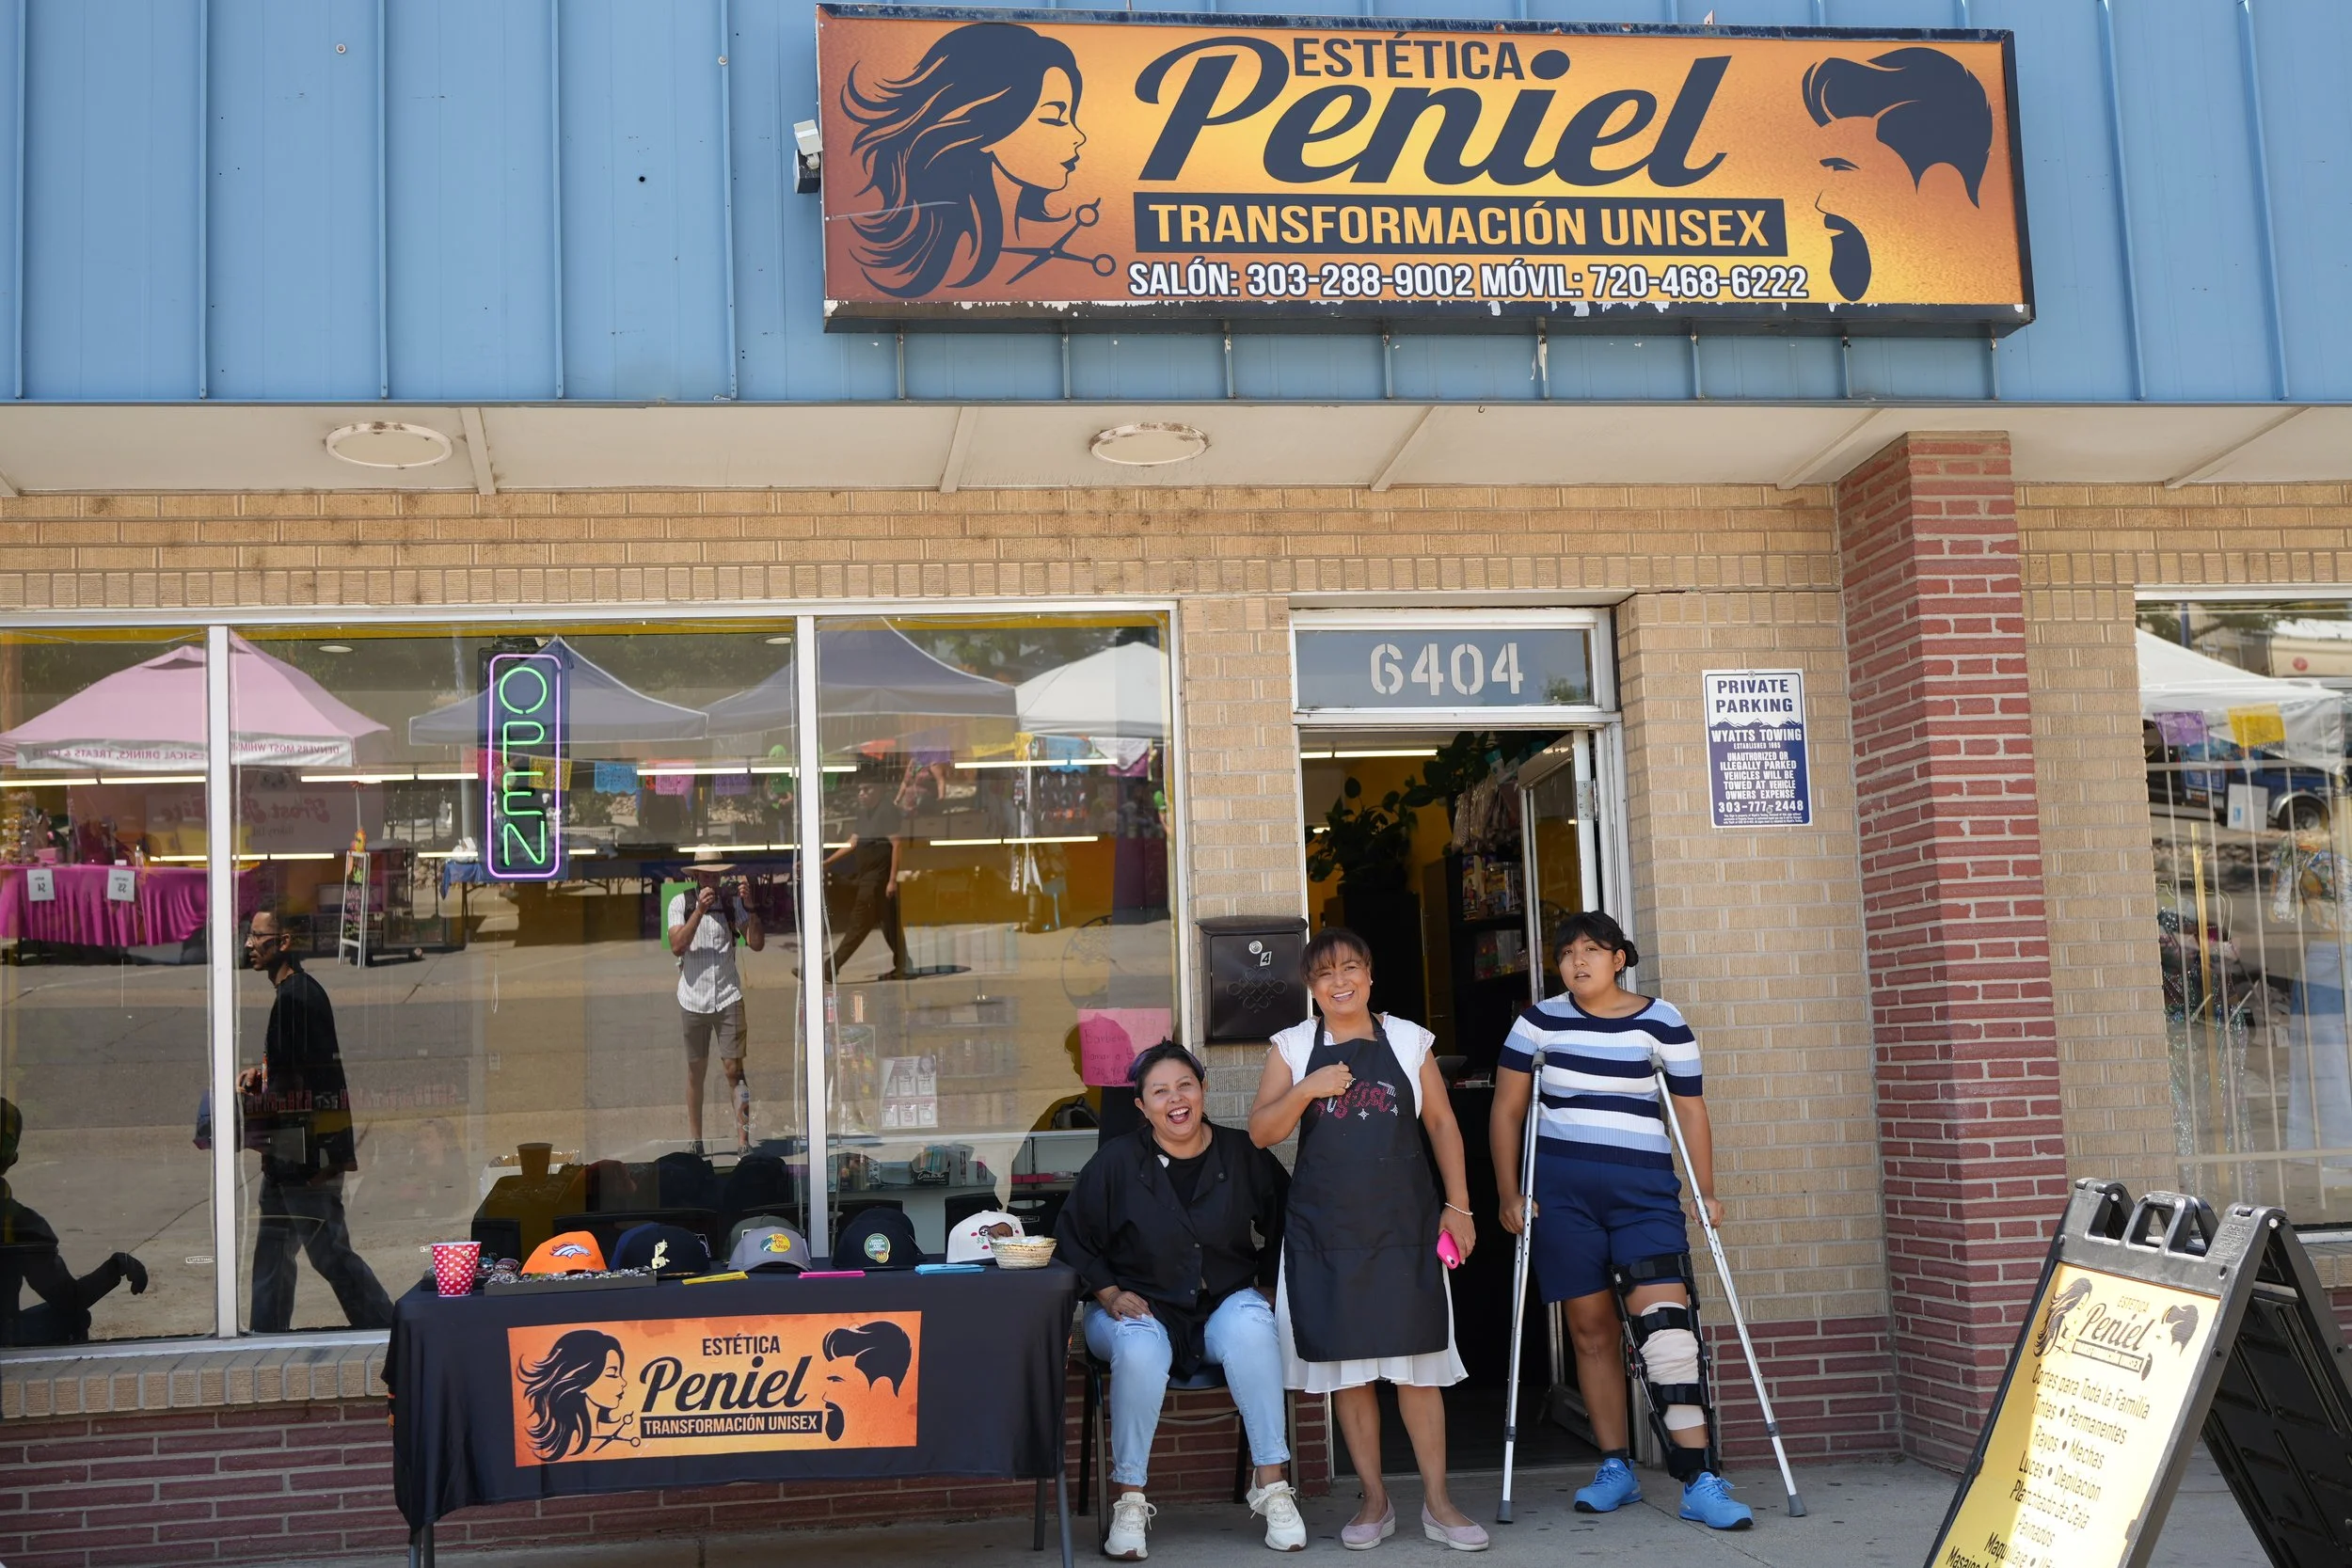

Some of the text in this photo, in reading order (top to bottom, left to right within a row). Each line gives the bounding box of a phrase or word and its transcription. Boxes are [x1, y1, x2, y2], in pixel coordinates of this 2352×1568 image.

[1293, 31, 1525, 80] ESTÉTICA
[1135, 36, 1732, 187] Peniel
[1149, 200, 1770, 247] TRANSFORMACIÓN UNISEX
[1129, 257, 1808, 298] SALÓN: 303-288-9002 MÓVIL: 720-468-6222
[1370, 641, 1523, 697] 6404
[1717, 679, 1789, 694] PRIVATE
[1716, 698, 1793, 713] PARKING
[1711, 729, 1803, 743] WYATTS TOWING
[497, 666, 548, 866] OPEN
[1720, 760, 1797, 771] ILLEGALLY PARKED
[1727, 752, 1788, 761] UNAUTHORIZED OR
[1724, 769, 1794, 781] VEHICLES WILL BE
[1724, 780, 1796, 790] TOWED AT VEHICLE
[1718, 800, 1804, 813] 303-777-2448
[1725, 789, 1795, 800] OWNERS EXPENSE
[1262, 953, 1270, 964] 4
[2078, 1302, 2155, 1352] Peniel
[702, 1334, 781, 1356] ESTÉTICA
[639, 1355, 813, 1413] Peniel
[2031, 1363, 2151, 1420] Cortes para Toda la Familia
[644, 1413, 818, 1436] TRANSFORMACIÓN UNISEX
[2031, 1393, 2128, 1445] Tintes Permanentes
[2032, 1424, 2106, 1469] Rayos Mechas
[2017, 1449, 2045, 1480] Luces
[2010, 1479, 2057, 1515] Planchado
[2053, 1499, 2069, 1520] de
[2013, 1513, 2056, 1548] Peinados
[1983, 1531, 2028, 1568] Maquillaje
